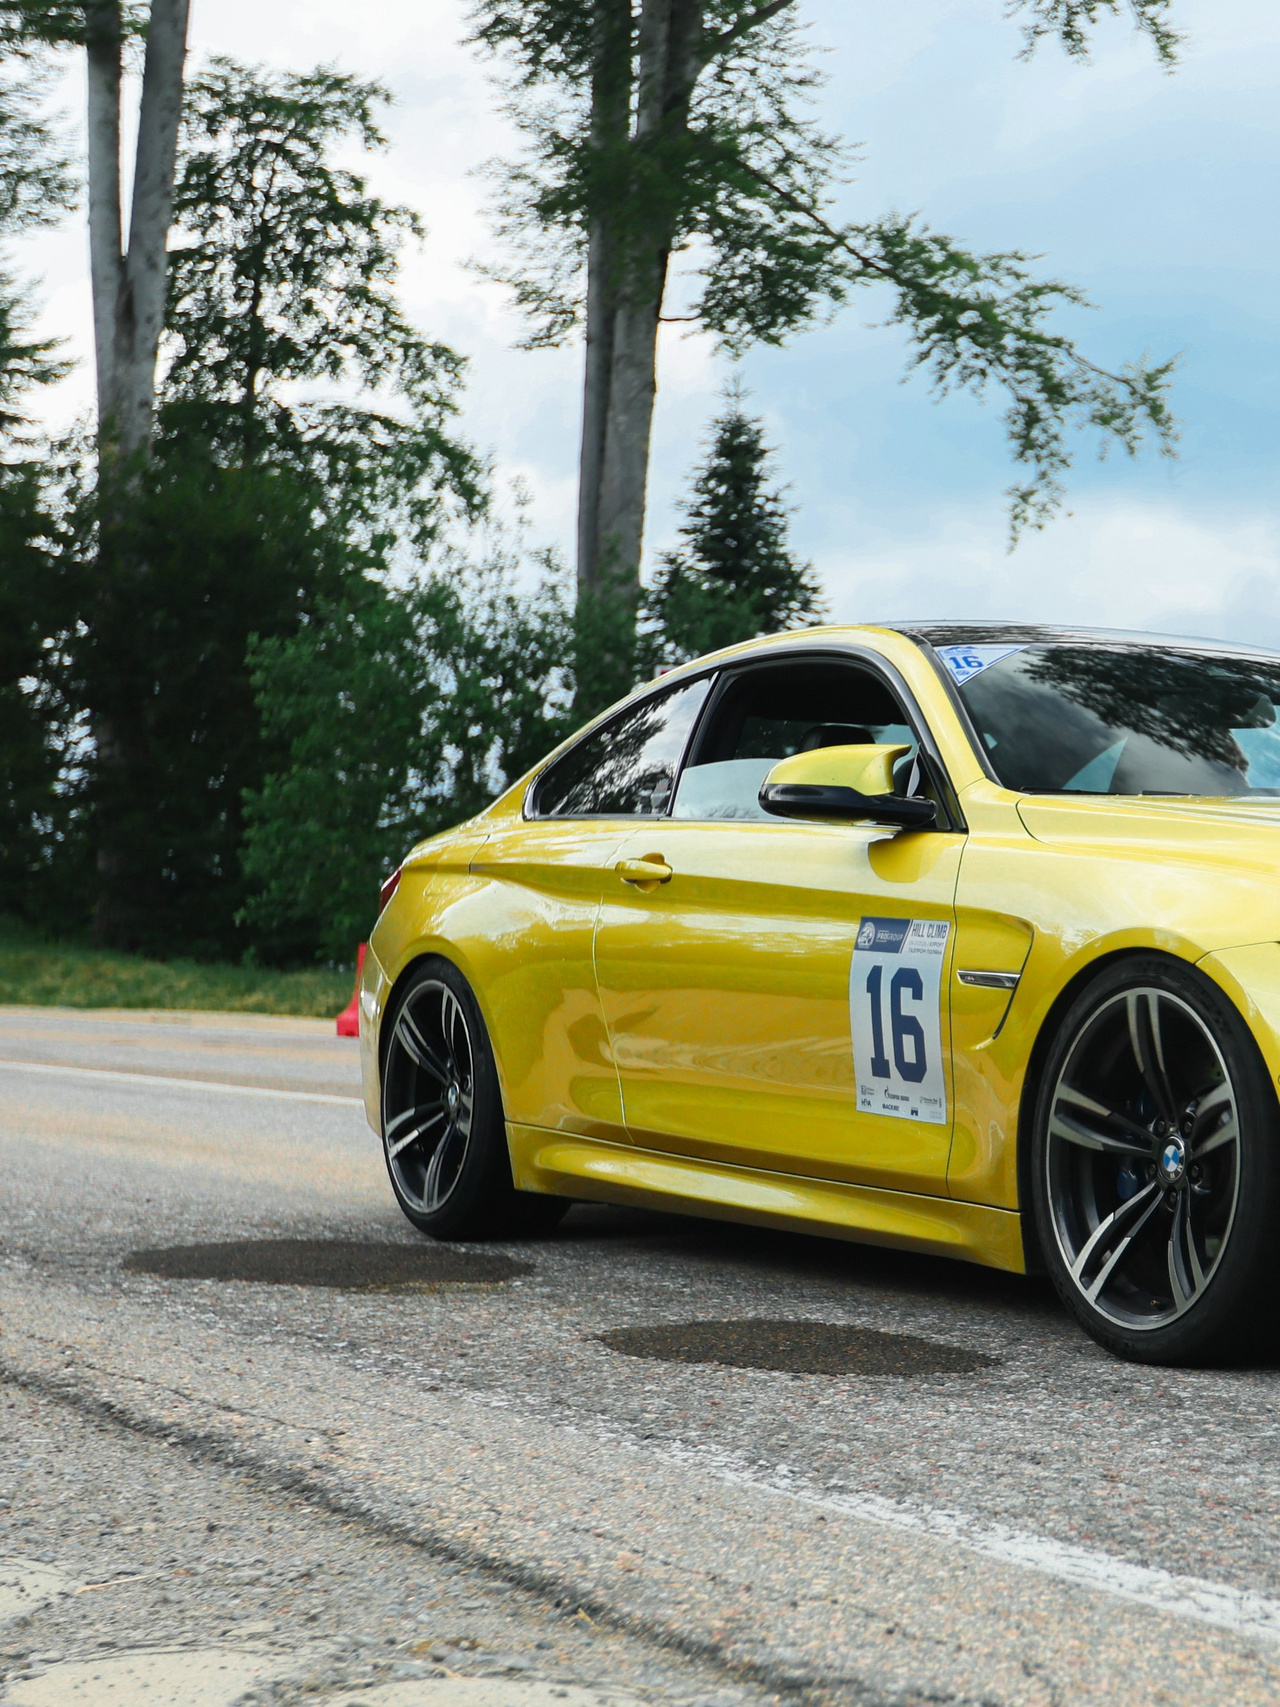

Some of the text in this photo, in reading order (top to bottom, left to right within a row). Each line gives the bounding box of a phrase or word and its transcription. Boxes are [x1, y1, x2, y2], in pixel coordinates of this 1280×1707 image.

[949, 655, 984, 669] 16
[911, 923, 948, 939] HILL CLIMB
[866, 965, 927, 1084] 16
